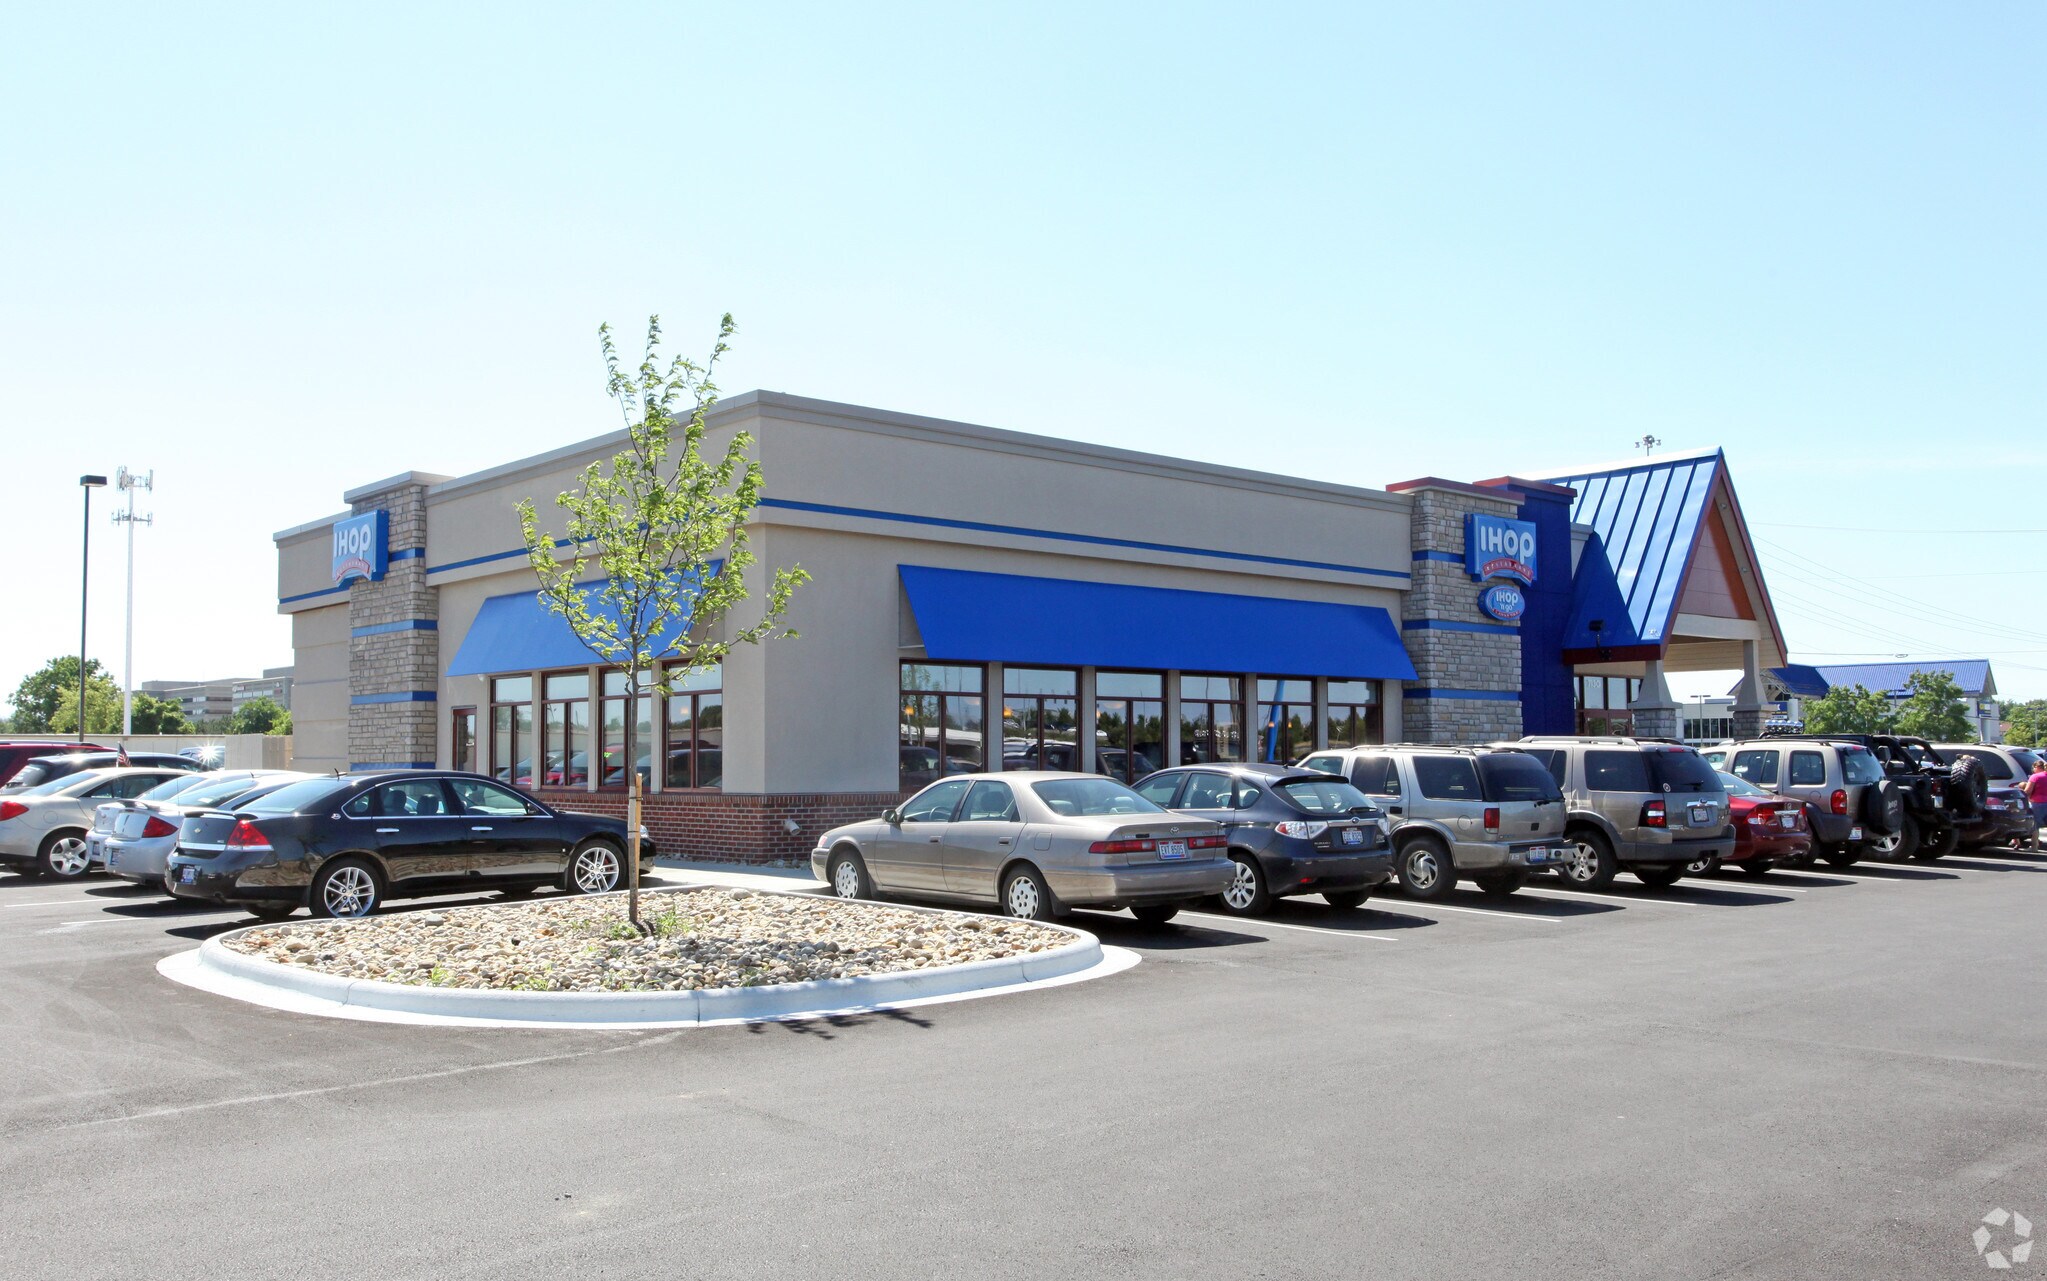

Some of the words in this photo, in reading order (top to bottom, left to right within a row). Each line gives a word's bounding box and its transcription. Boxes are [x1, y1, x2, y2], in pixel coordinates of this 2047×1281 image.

[334, 524, 371, 559] IHOP
[1481, 525, 1535, 565] IHOP
[1496, 591, 1518, 606] IHOP
